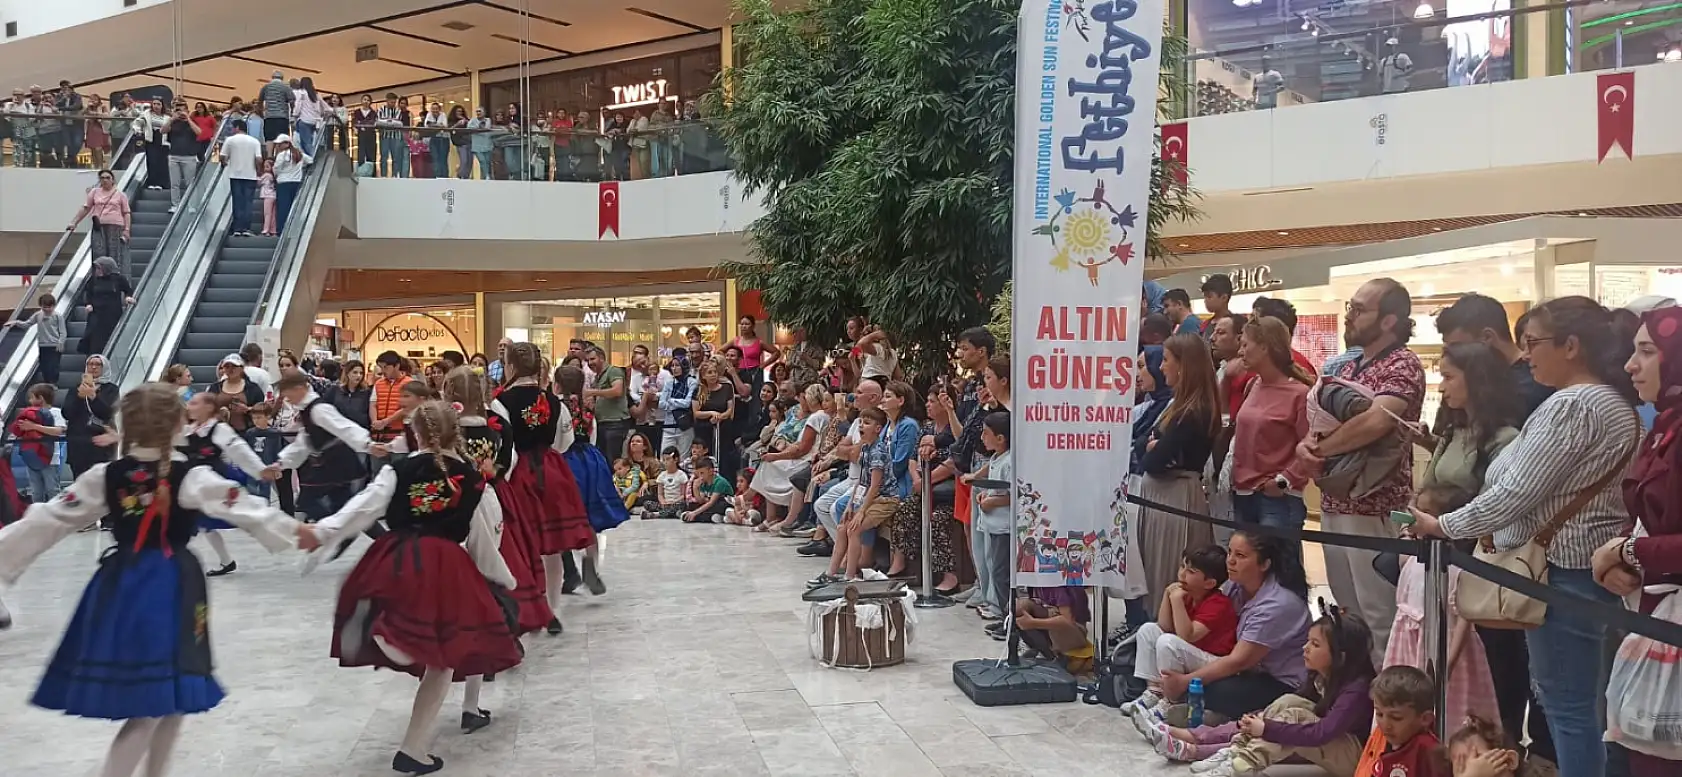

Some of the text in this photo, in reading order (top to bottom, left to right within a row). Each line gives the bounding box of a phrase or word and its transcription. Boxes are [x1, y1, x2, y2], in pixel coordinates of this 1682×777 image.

[1042, 46, 1058, 72] SUN
[611, 79, 667, 104] TWIST
[1039, 75, 1056, 123] GOLDEN
[1034, 125, 1053, 220] INTERNATIONAL
[583, 311, 626, 324] ATASAY
[1036, 306, 1128, 342] ALTIN
[377, 325, 429, 342] DeFacto
[1027, 348, 1133, 395] GÜNEŞ
[1025, 402, 1132, 424] KÜLTÜR SANAT
[1046, 430, 1111, 451] DERNEĞİ
